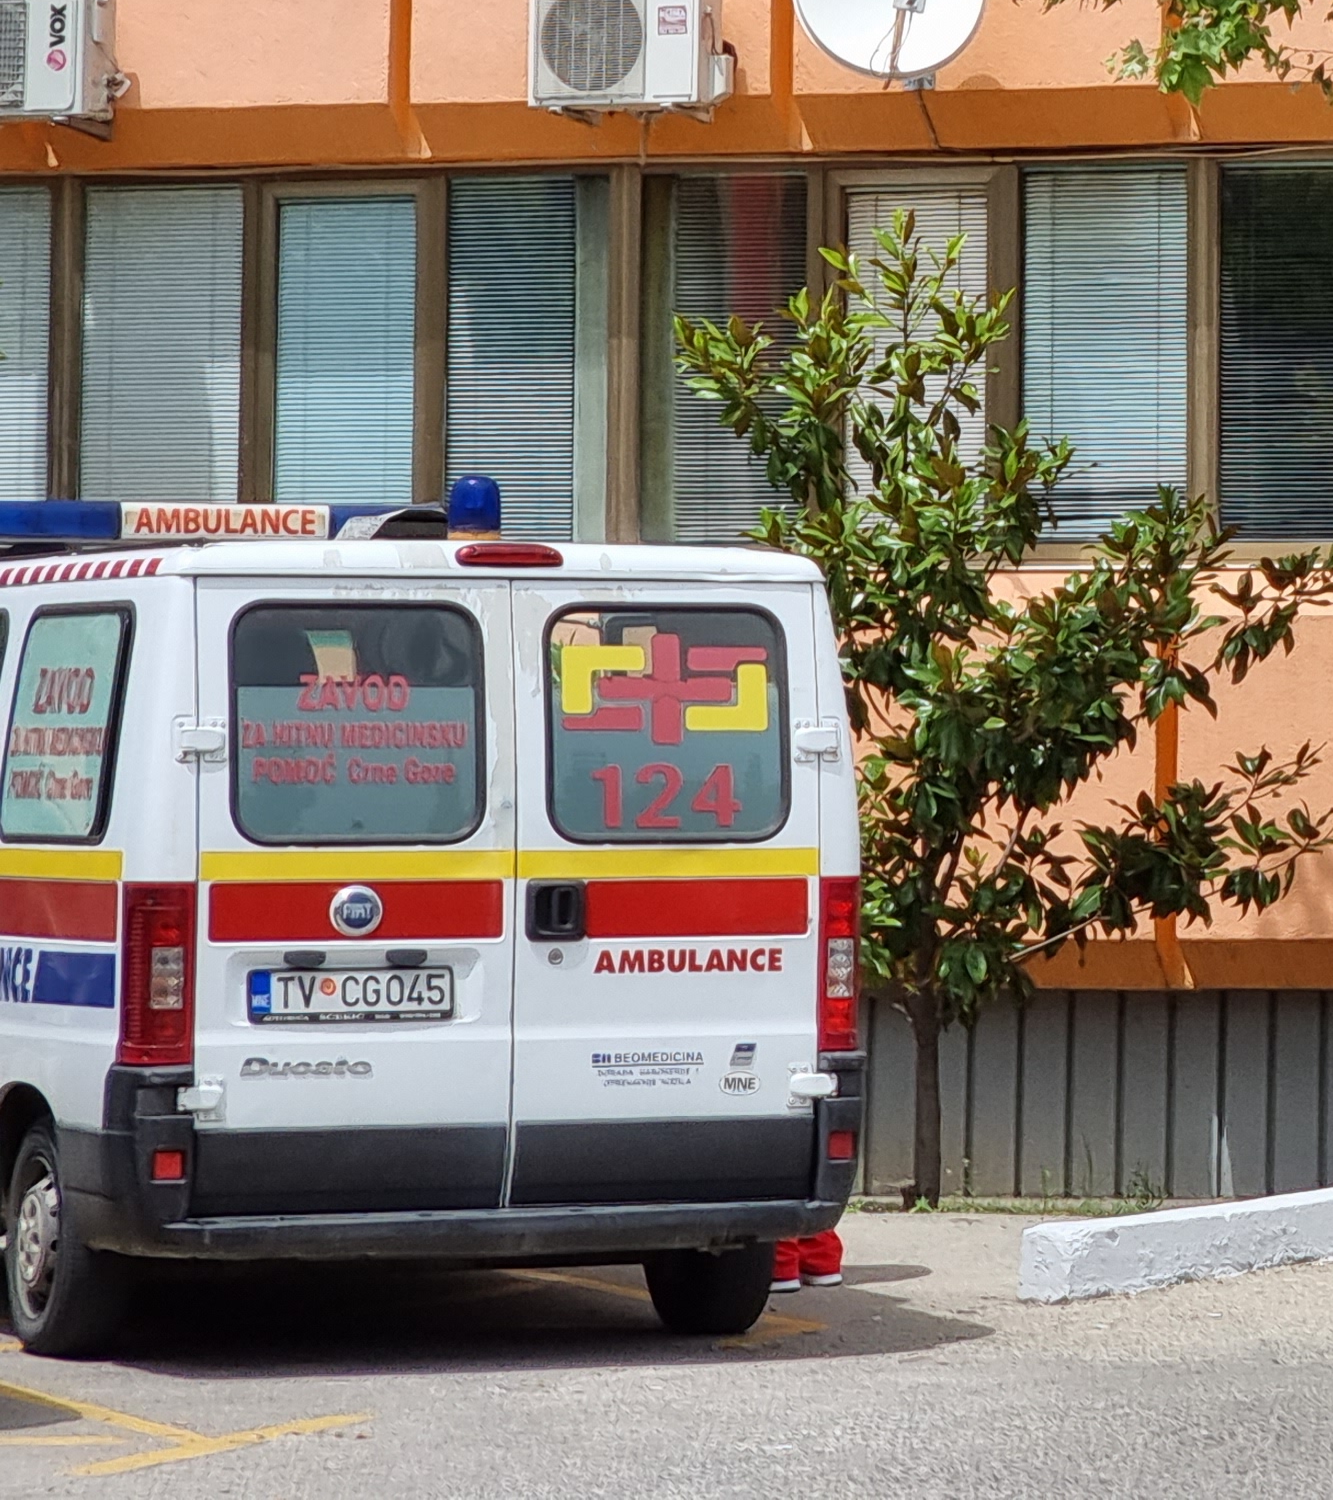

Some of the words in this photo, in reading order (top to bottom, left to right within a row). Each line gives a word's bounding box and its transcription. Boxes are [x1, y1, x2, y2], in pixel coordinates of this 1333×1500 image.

[49, 3, 67, 49] VOX
[134, 507, 316, 535] AMBULANCE
[297, 671, 410, 712] ZAVOD
[591, 762, 742, 828] 124
[594, 948, 783, 974] AMBULANCE
[276, 975, 316, 1009] TV
[340, 973, 446, 1007] CG045
[240, 1056, 373, 1080] Ducato
[614, 1051, 704, 1063] BEOMEDICINA
[724, 1077, 756, 1090] MNE
